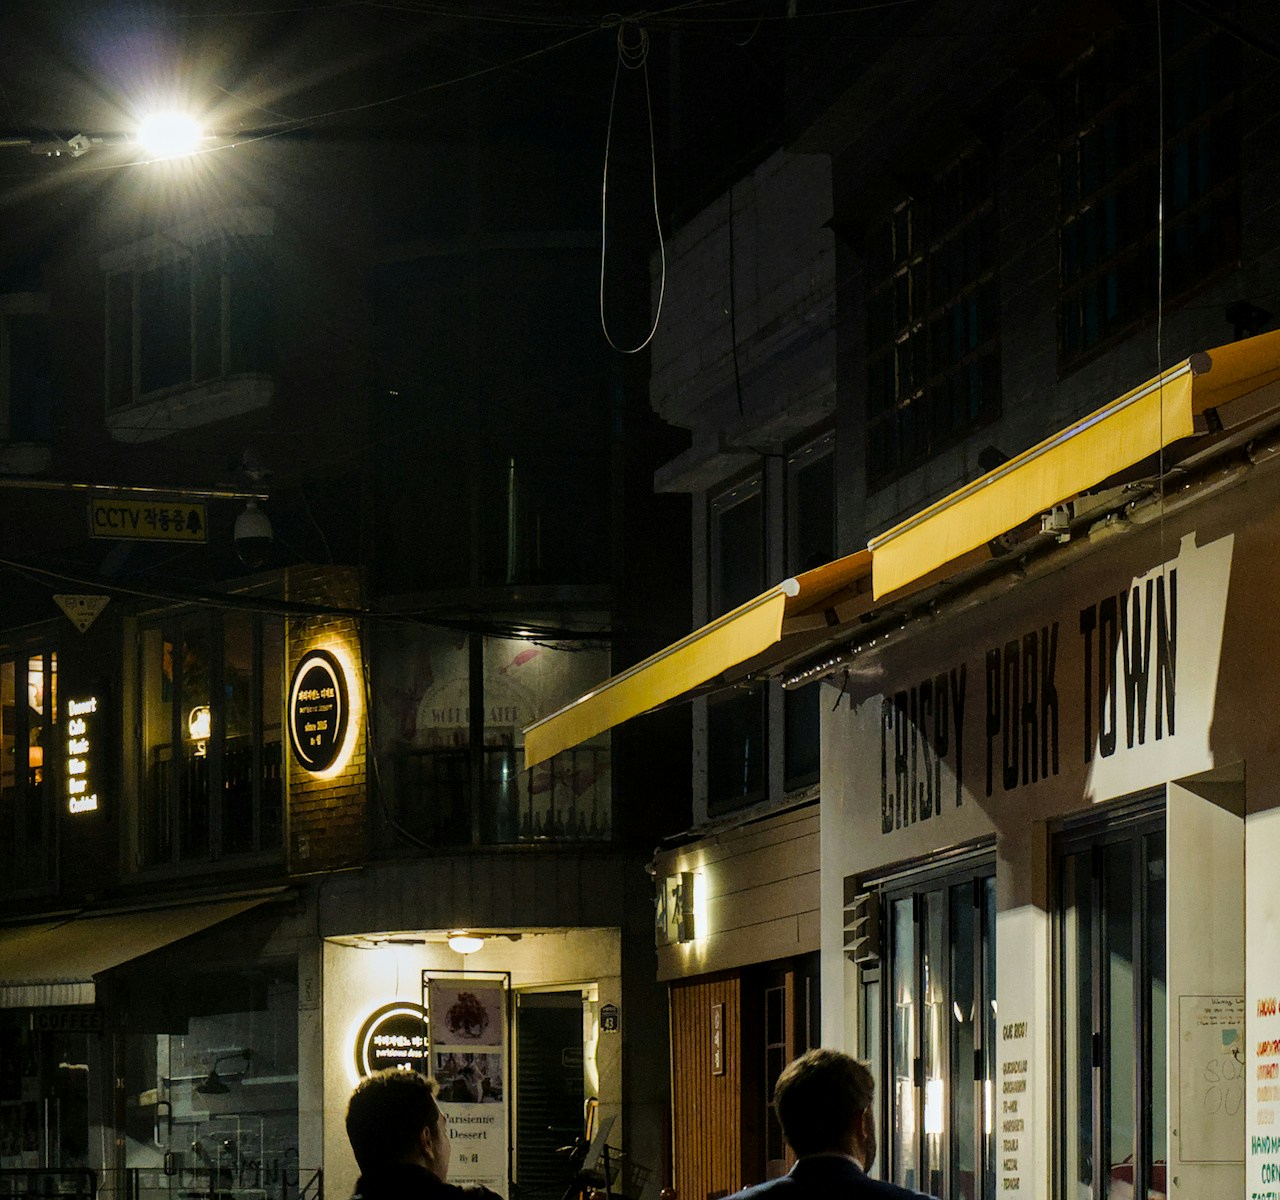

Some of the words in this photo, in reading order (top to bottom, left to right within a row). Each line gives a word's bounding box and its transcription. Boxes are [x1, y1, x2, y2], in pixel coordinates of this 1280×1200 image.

[95, 507, 140, 528] CCTV
[880, 662, 967, 835] CRISPY
[985, 622, 1059, 797] PORK
[1079, 567, 1178, 764] TOWN
[39, 1013, 98, 1028] COFFEE
[450, 1129, 487, 1139] Dessert
[1261, 1163, 1280, 1184] CORN
